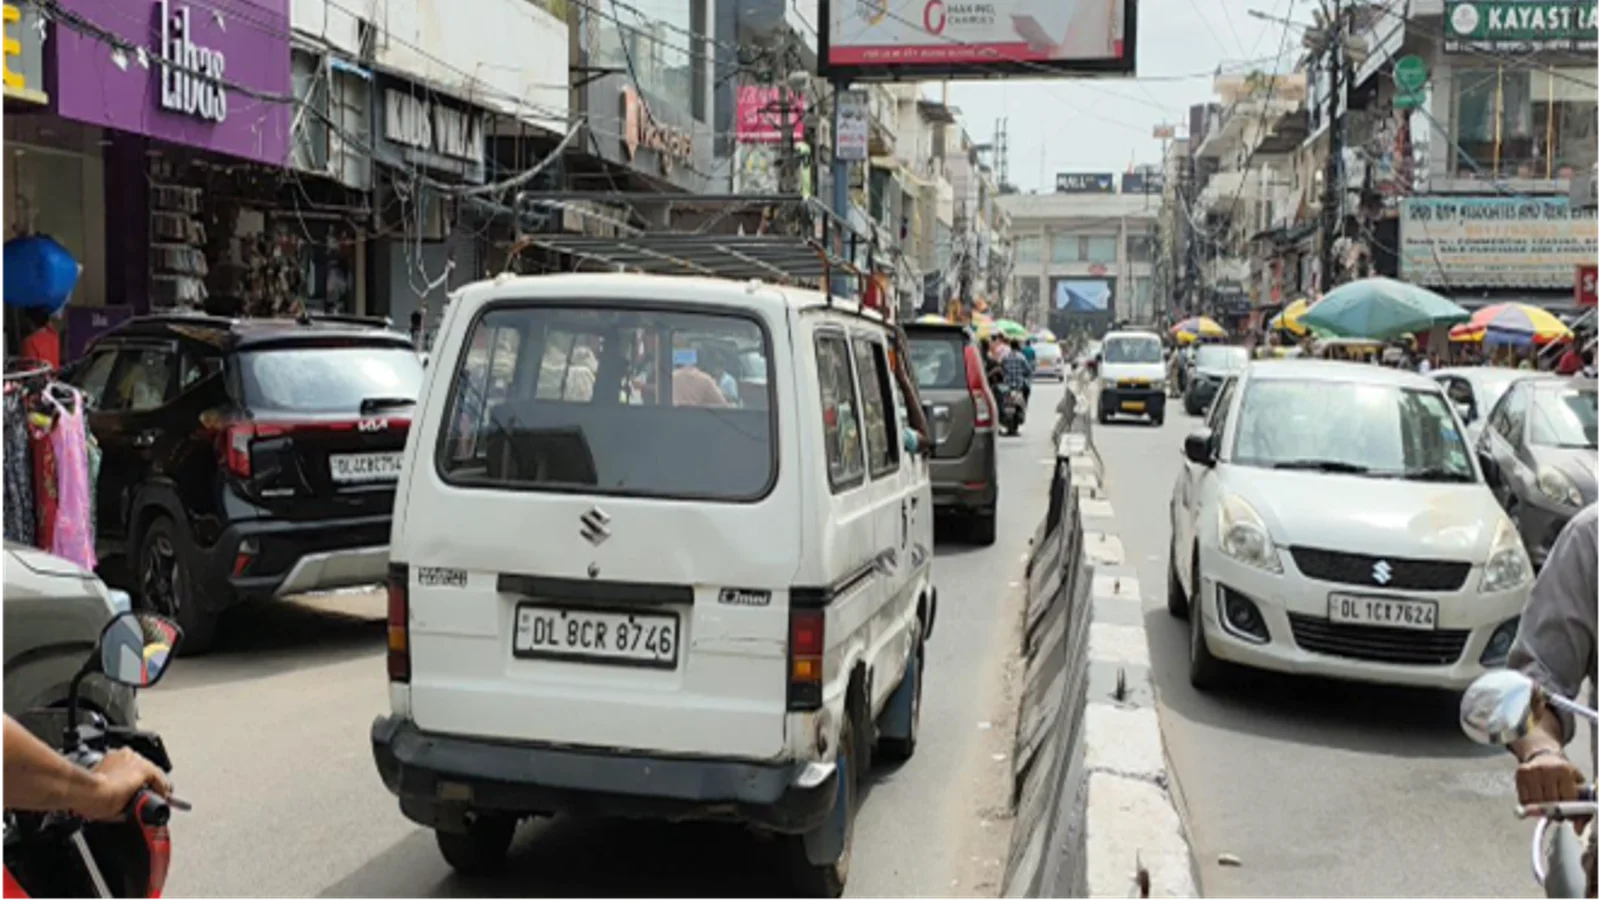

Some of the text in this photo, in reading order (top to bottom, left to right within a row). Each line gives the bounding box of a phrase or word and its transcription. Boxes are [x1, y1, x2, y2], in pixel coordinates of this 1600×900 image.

[162, 0, 226, 123] Libas
[533, 617, 672, 654] DL 8CR 8746
